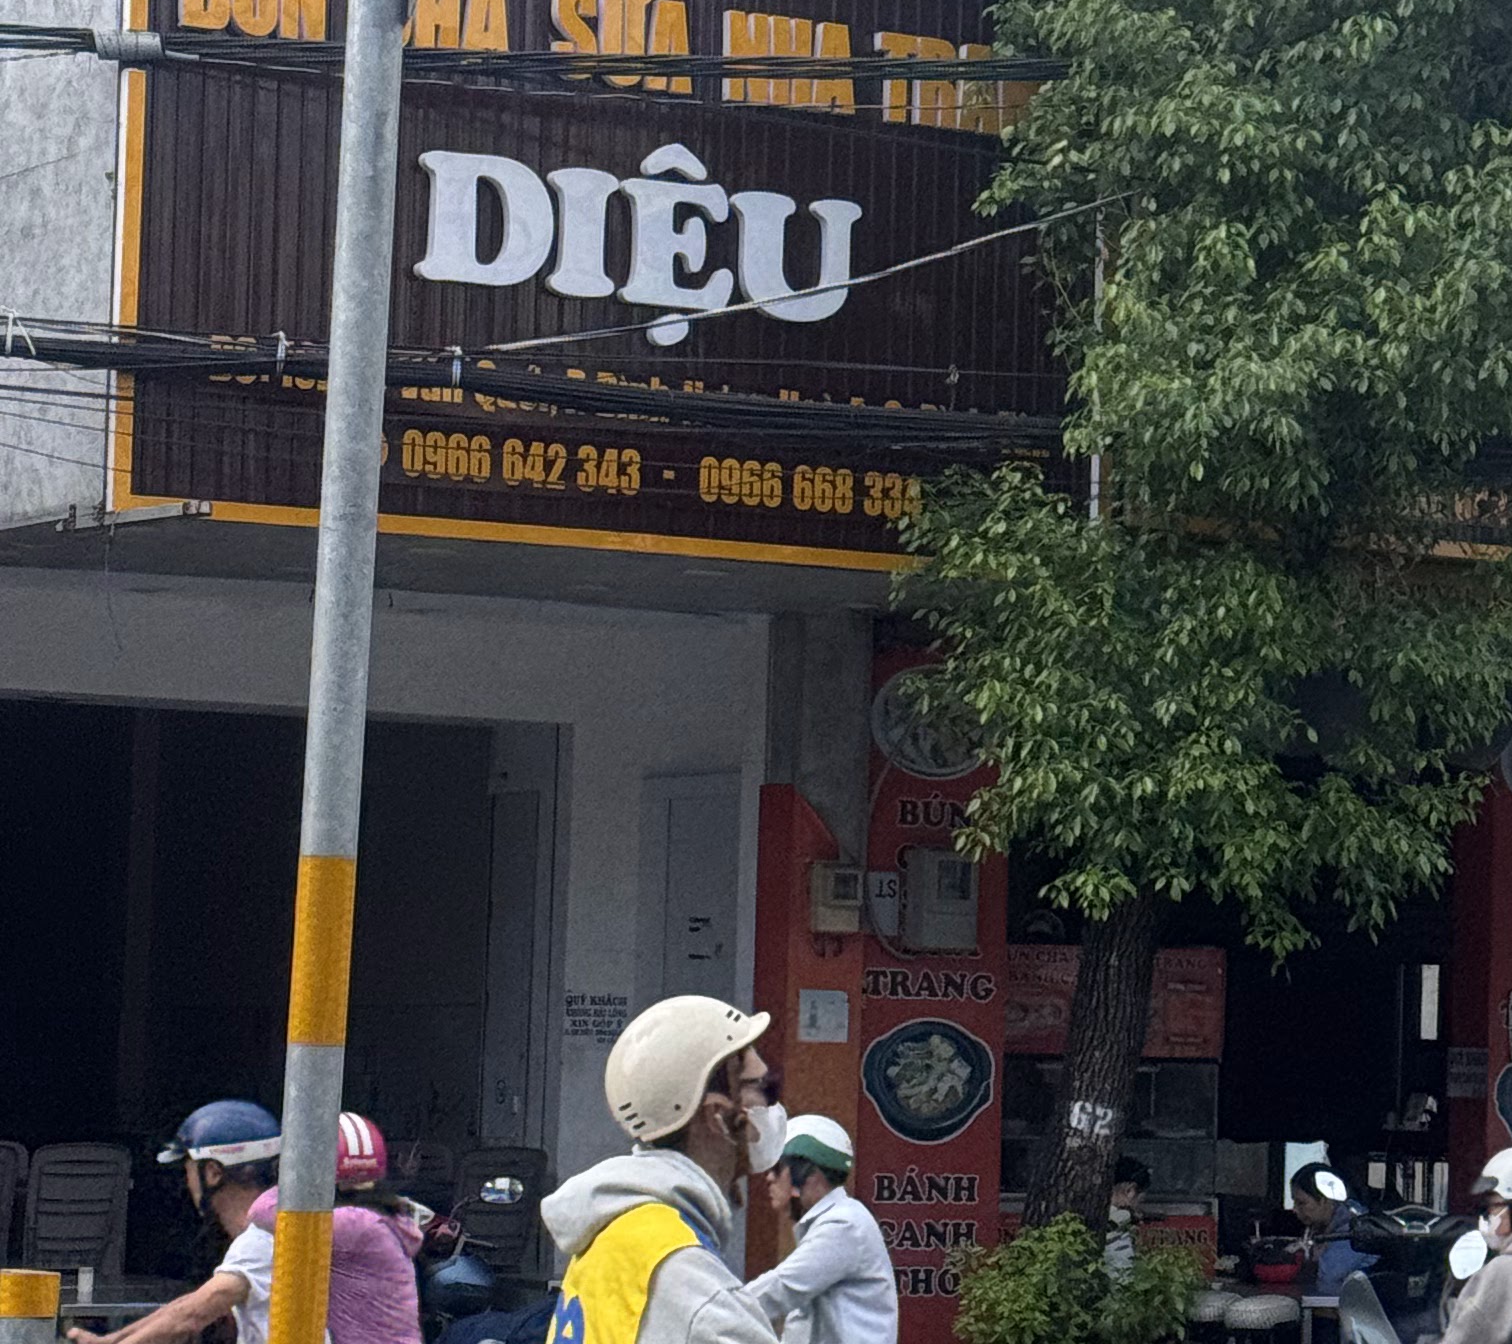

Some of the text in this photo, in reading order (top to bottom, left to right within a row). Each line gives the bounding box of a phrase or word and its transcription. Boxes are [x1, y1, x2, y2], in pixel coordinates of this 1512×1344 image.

[721, 9, 856, 115] NHA
[414, 143, 863, 346] DIỆU
[402, 428, 491, 483] 0966
[501, 438, 567, 490] 642
[576, 445, 641, 497] 343
[700, 456, 783, 509] 0966
[792, 464, 854, 516] 668
[864, 967, 997, 1003] TRANG
[873, 1165, 979, 1205] BÁNH
